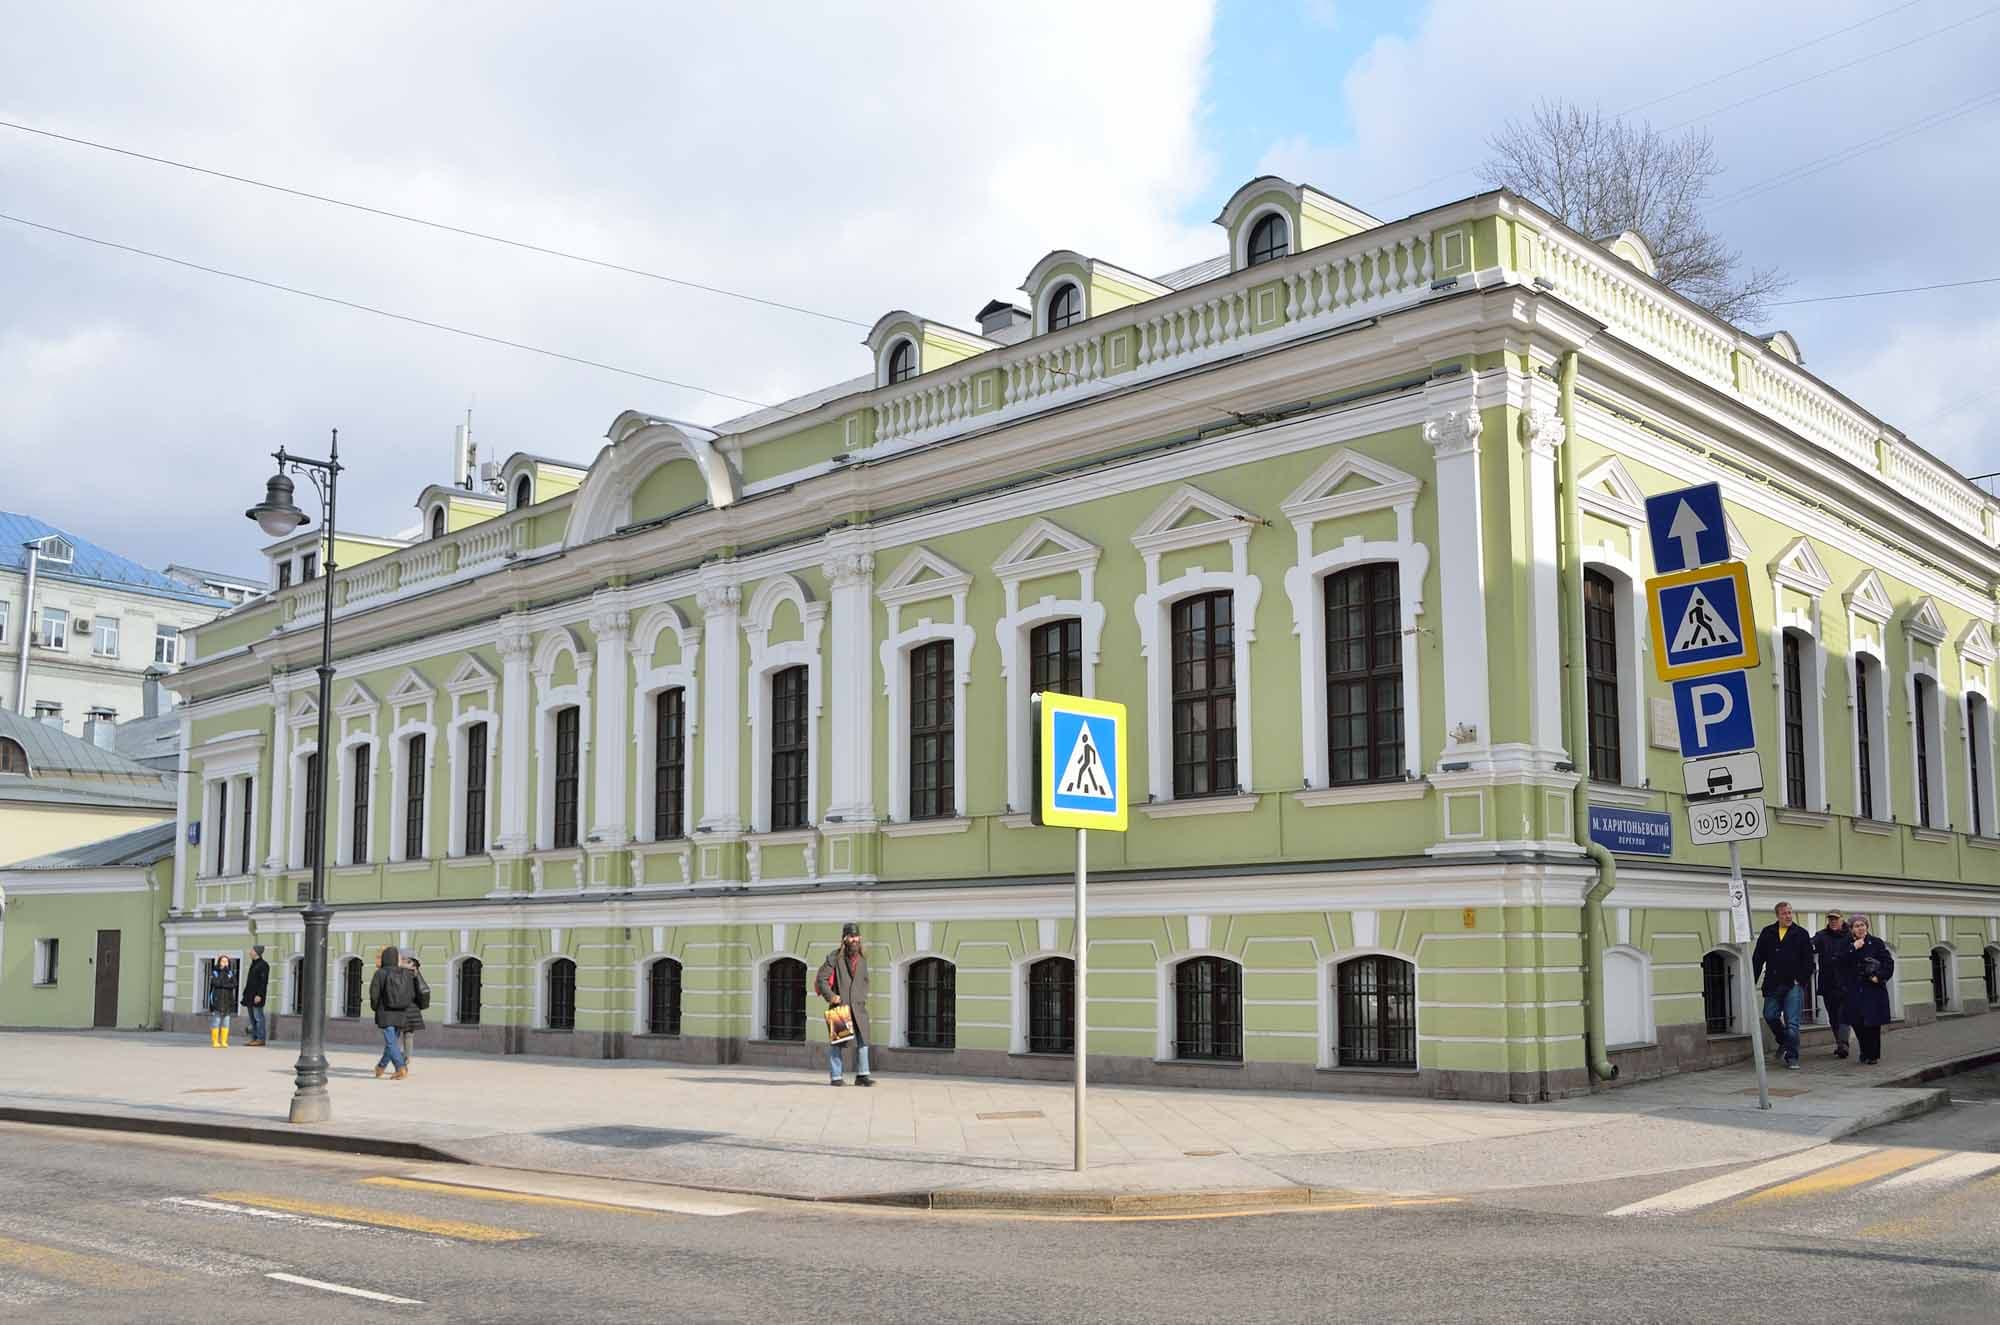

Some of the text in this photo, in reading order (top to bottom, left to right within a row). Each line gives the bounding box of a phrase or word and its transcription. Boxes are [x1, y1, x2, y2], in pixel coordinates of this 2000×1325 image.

[1691, 683, 1734, 747] P
[1592, 817, 1669, 837] М. ХАРИТОНЬЕВСКИЙ
[1697, 811, 1756, 830] 10 15 20
